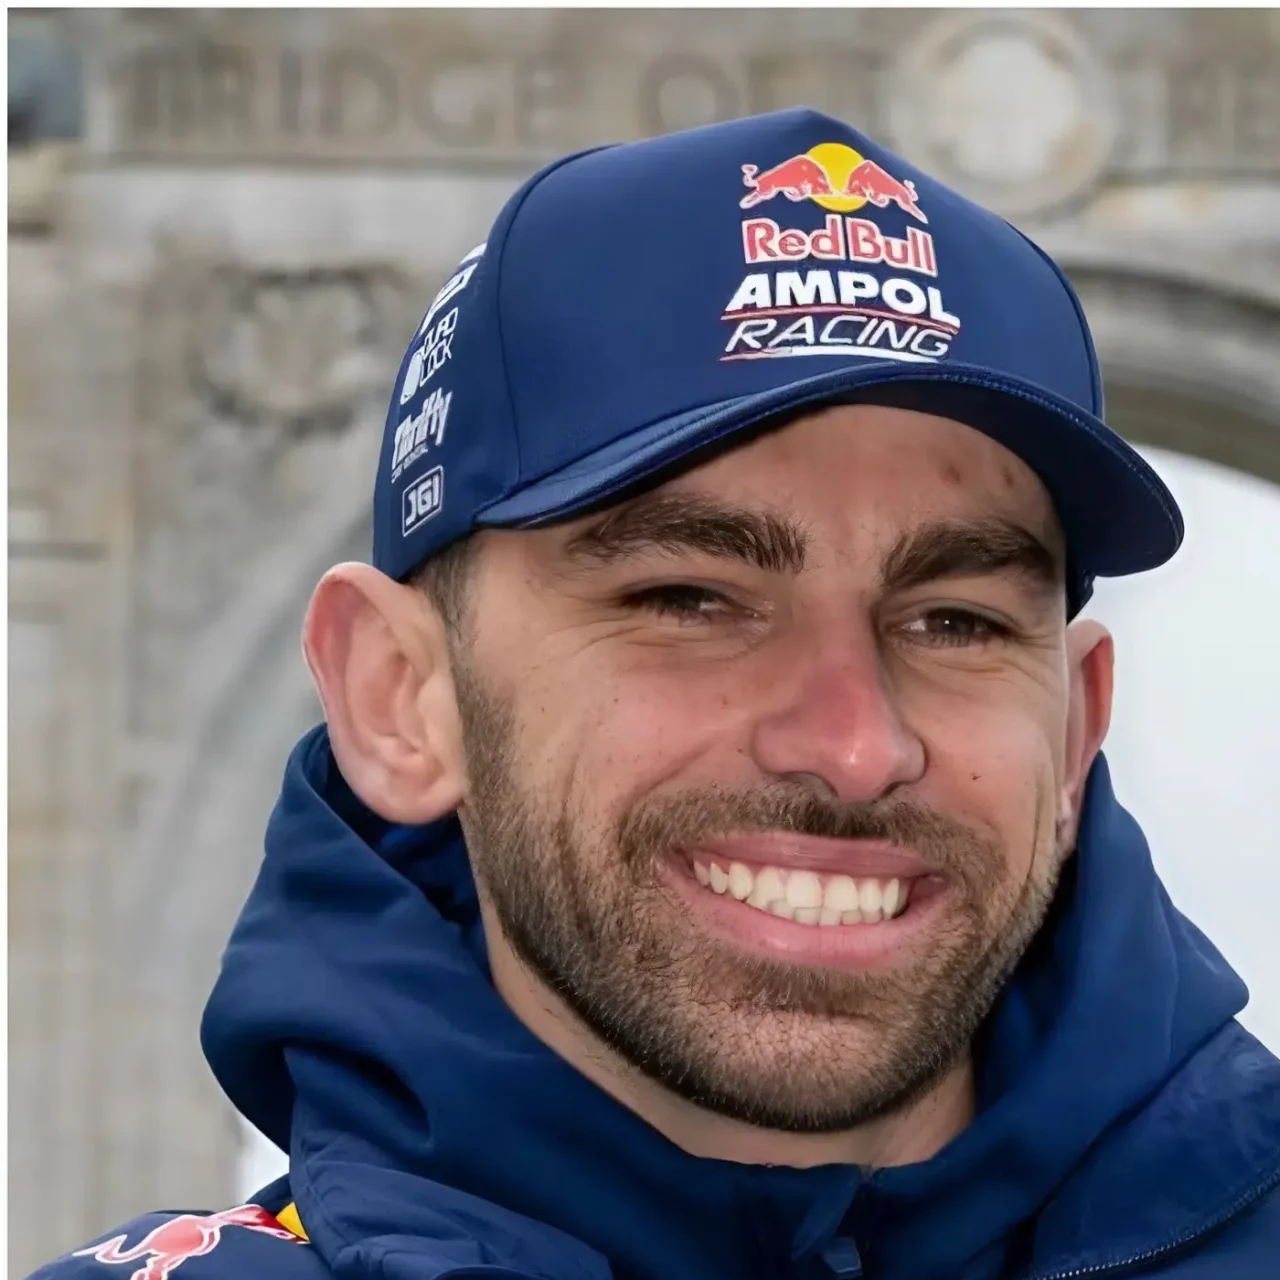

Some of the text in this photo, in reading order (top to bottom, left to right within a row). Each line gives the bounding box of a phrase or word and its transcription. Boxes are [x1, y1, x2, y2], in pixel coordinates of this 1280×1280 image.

[742, 213, 939, 278] Red Bull
[725, 269, 961, 331] AMPOL
[724, 314, 953, 357] RACING
[405, 474, 441, 528] JGI
